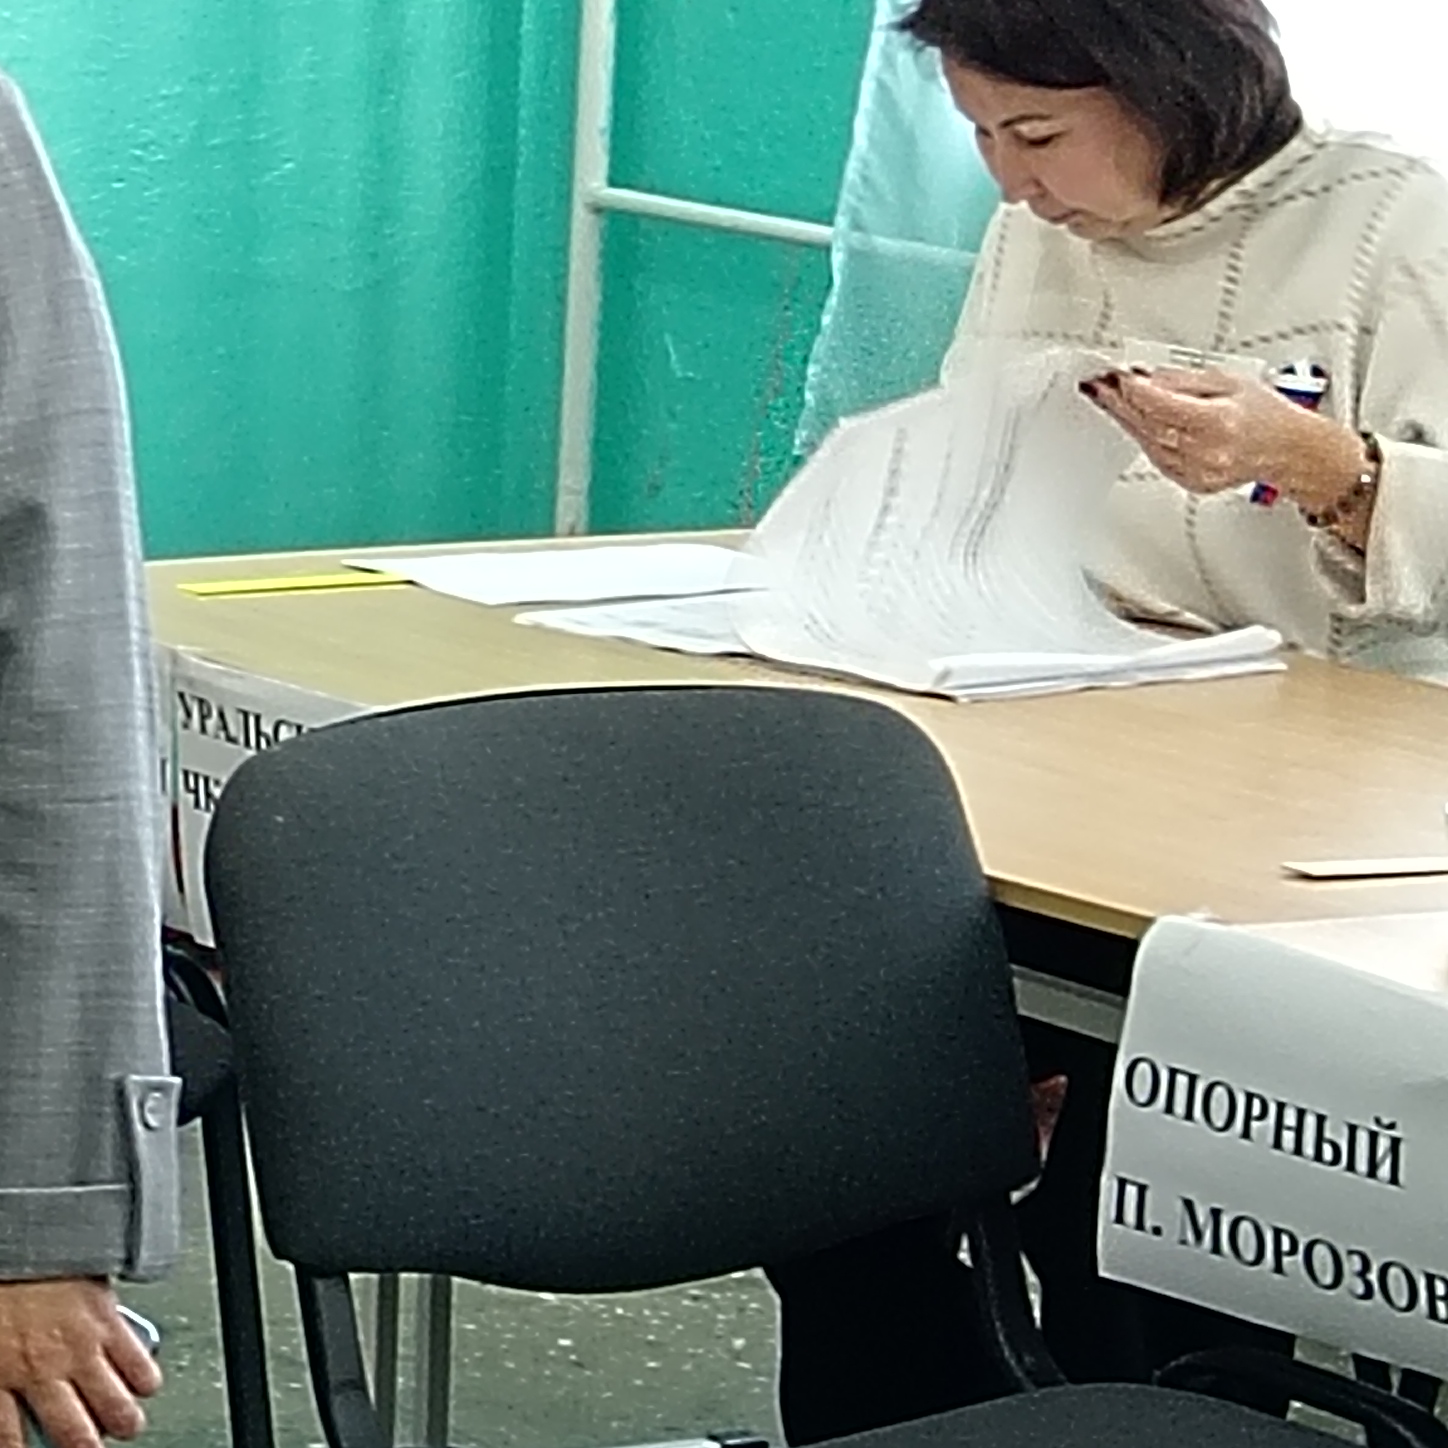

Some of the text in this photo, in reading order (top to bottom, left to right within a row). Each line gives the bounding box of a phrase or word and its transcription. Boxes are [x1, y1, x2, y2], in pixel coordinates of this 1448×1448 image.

[177, 690, 304, 752] УРАЛЬС
[1124, 1055, 1408, 1189] ОПОРНЫЙ
[1112, 1173, 1164, 1238] П.
